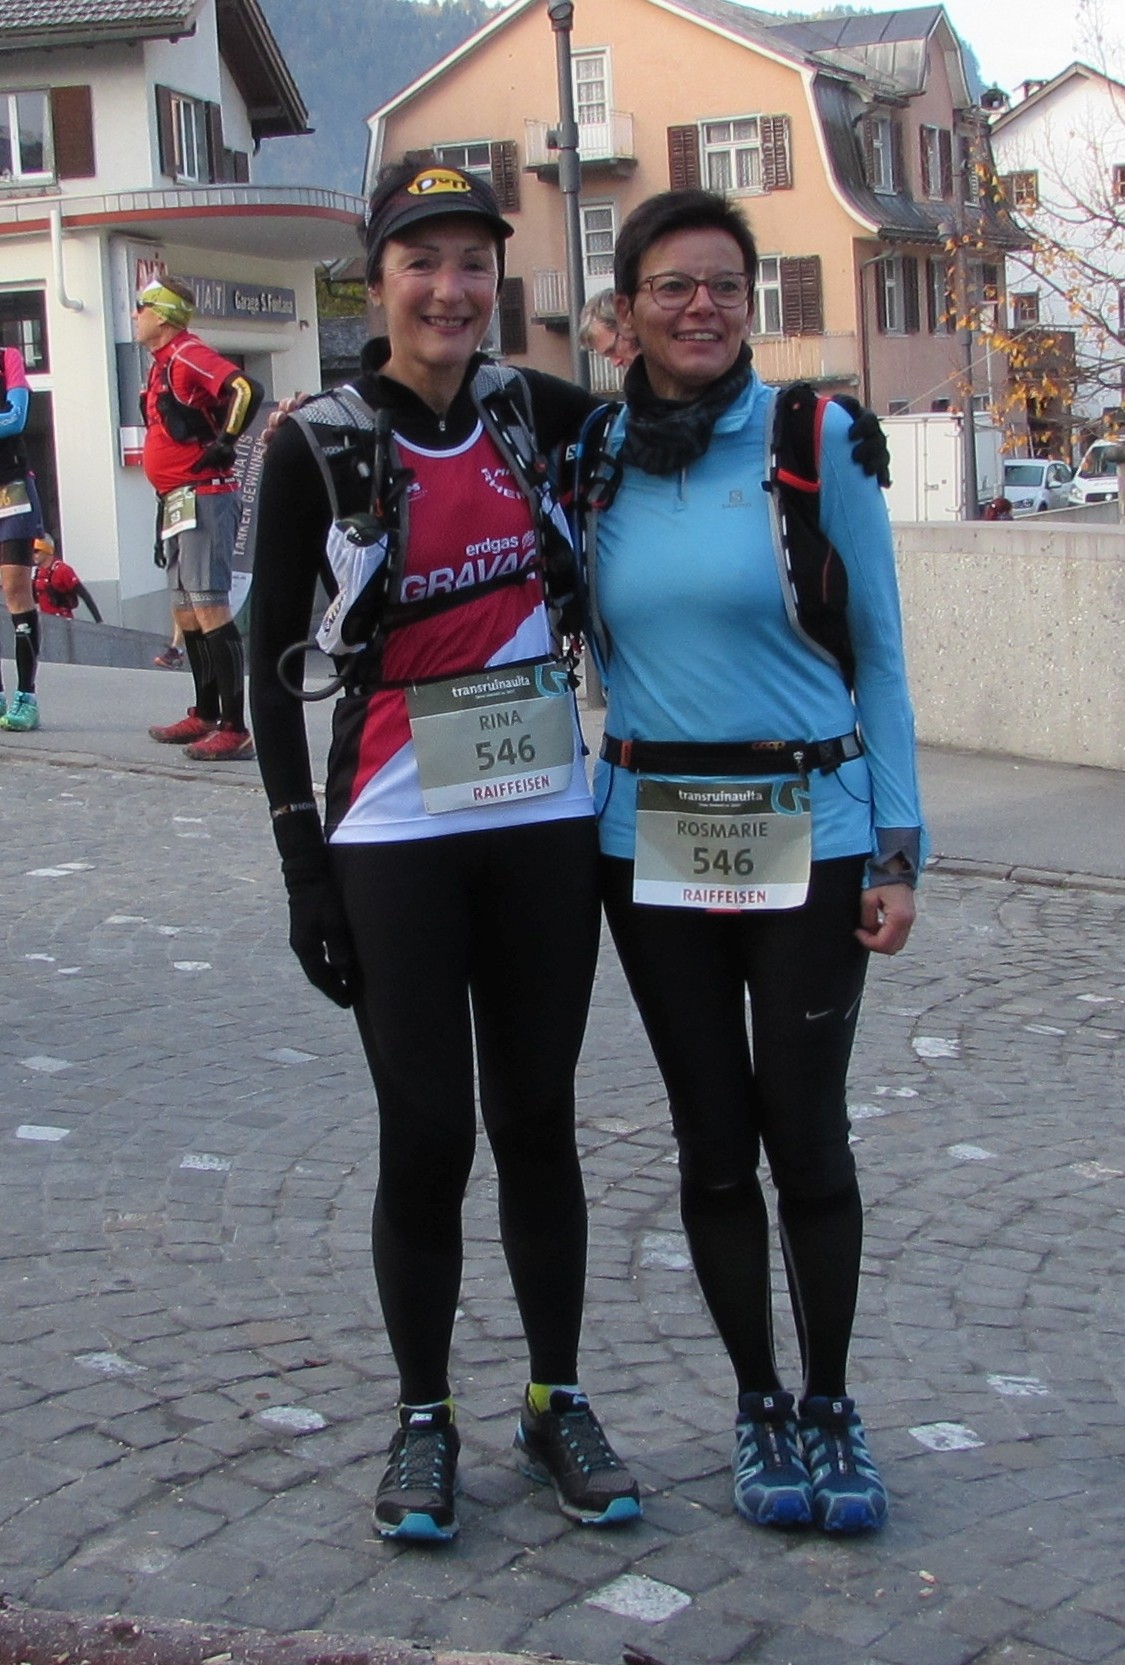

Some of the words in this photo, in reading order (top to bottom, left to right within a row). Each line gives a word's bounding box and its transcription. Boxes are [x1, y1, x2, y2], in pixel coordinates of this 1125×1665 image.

[234, 290, 259, 315] Garage
[232, 507, 252, 556] TANKEN
[465, 536, 519, 557] erdgas
[451, 675, 531, 698] transruinaulta
[479, 710, 523, 730] RINA
[476, 733, 536, 771] 546
[472, 775, 550, 801] RAIFFEISEN
[678, 789, 764, 802] transruinaulta
[677, 819, 769, 838] ROSMARIE
[693, 846, 755, 876] 546
[683, 888, 767, 904] RAIFFEISEN
